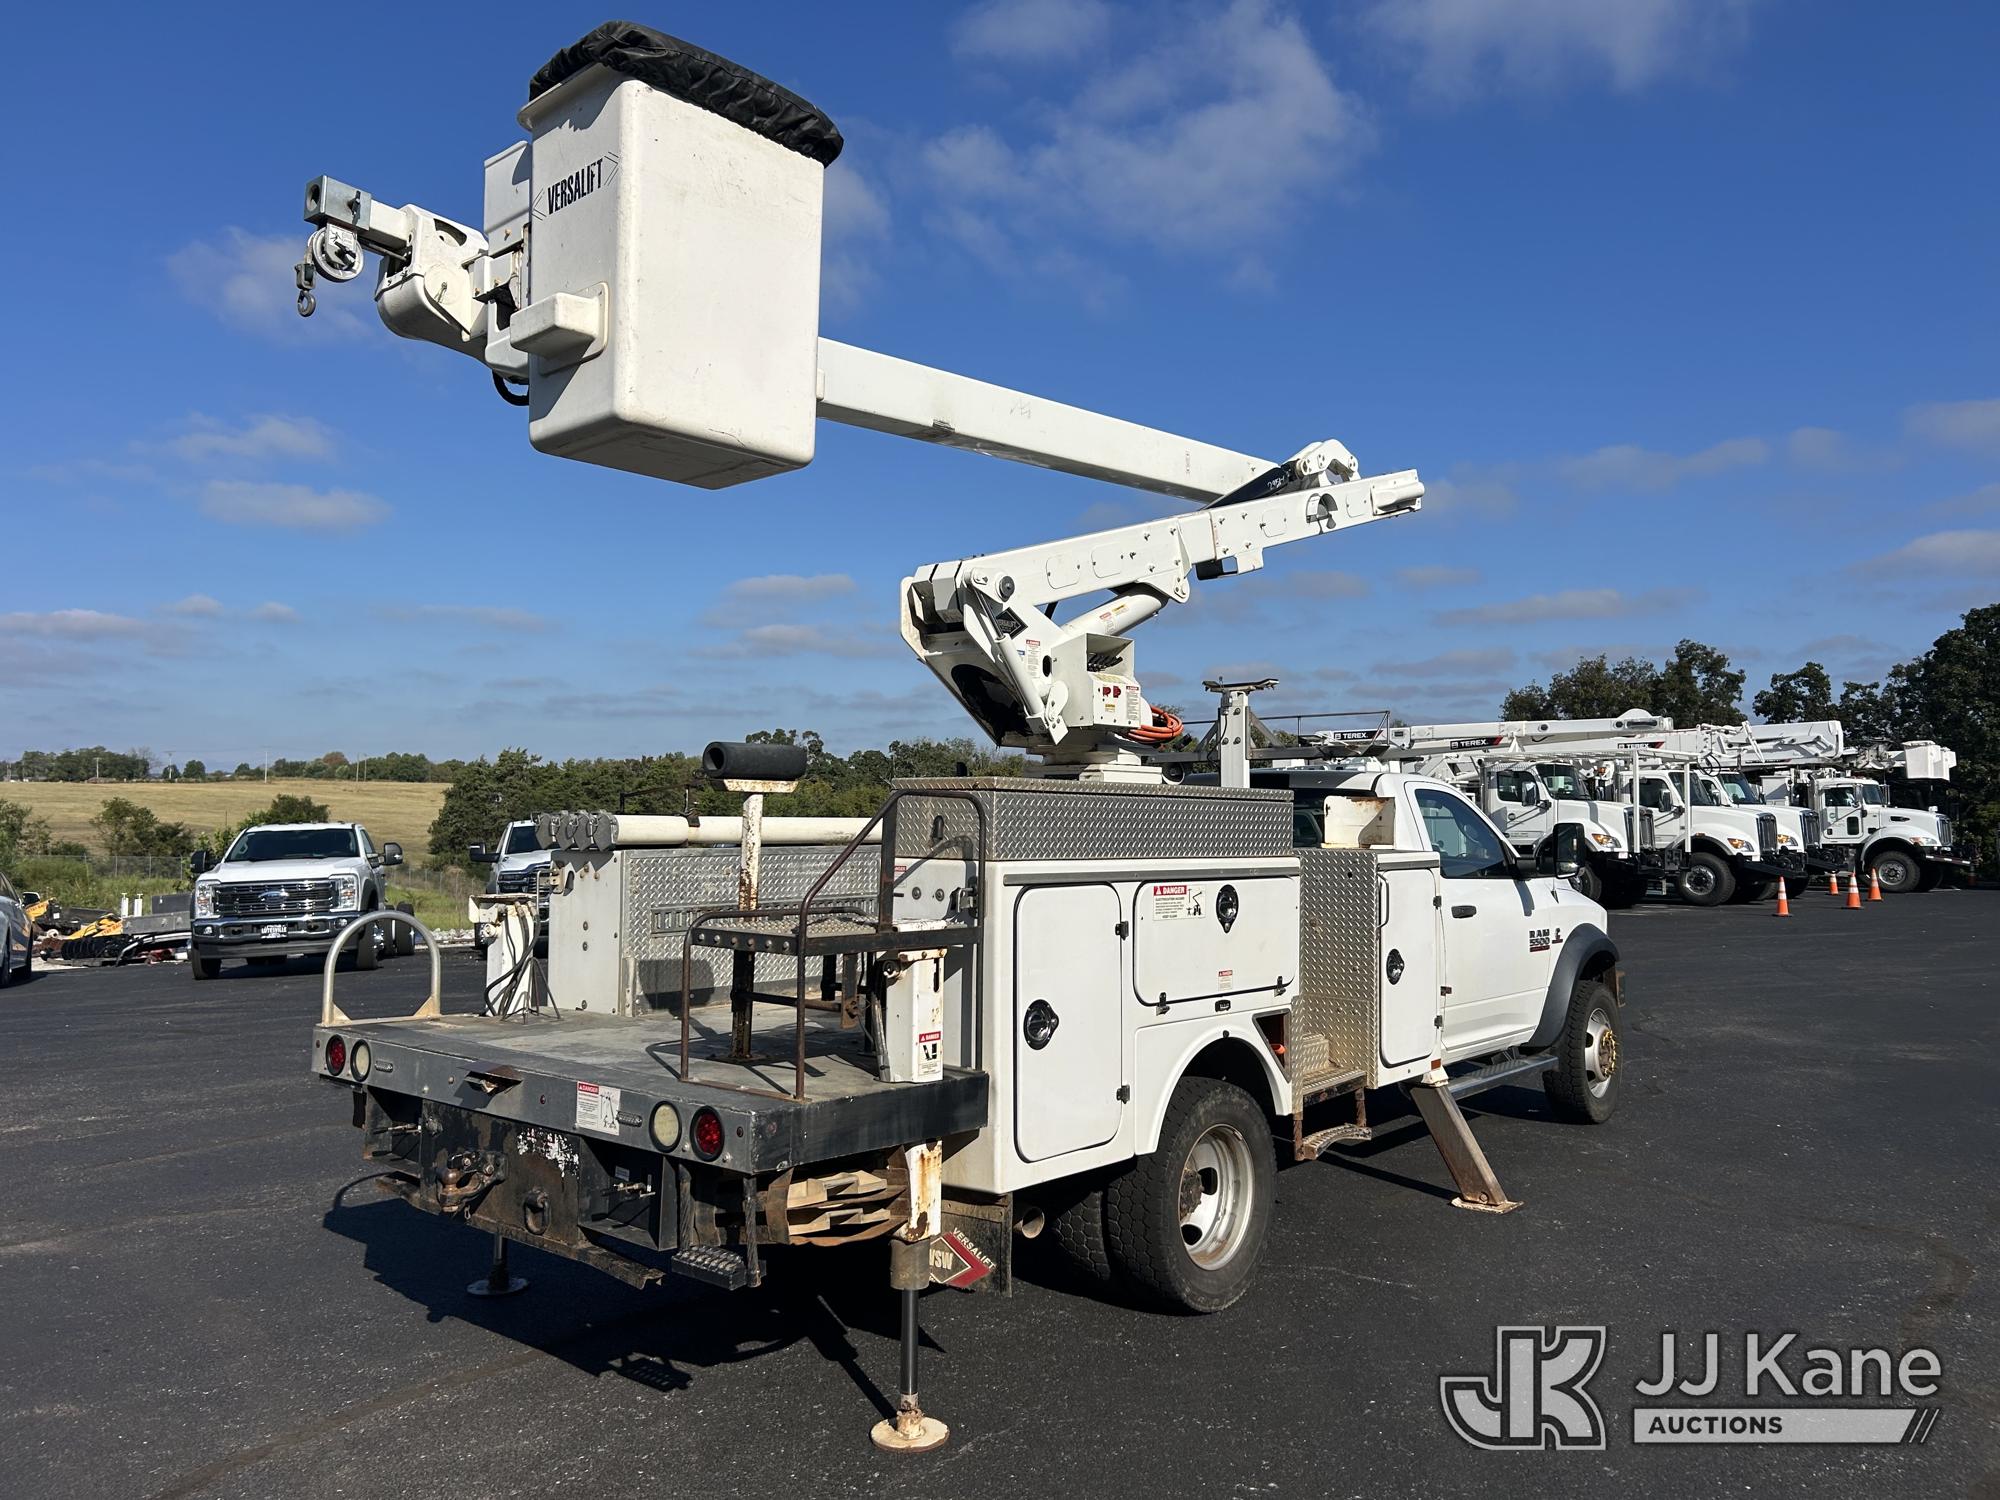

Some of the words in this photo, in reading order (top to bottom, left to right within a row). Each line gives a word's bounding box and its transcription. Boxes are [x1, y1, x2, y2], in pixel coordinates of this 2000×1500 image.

[547, 158, 603, 214] VERSALIFT
[1460, 739, 1486, 747] TEREX
[1163, 886, 1184, 895] DANGER
[1529, 929, 1550, 938] RAM
[582, 1084, 598, 1093] DANGER
[952, 1227, 997, 1270] VERSALIFT
